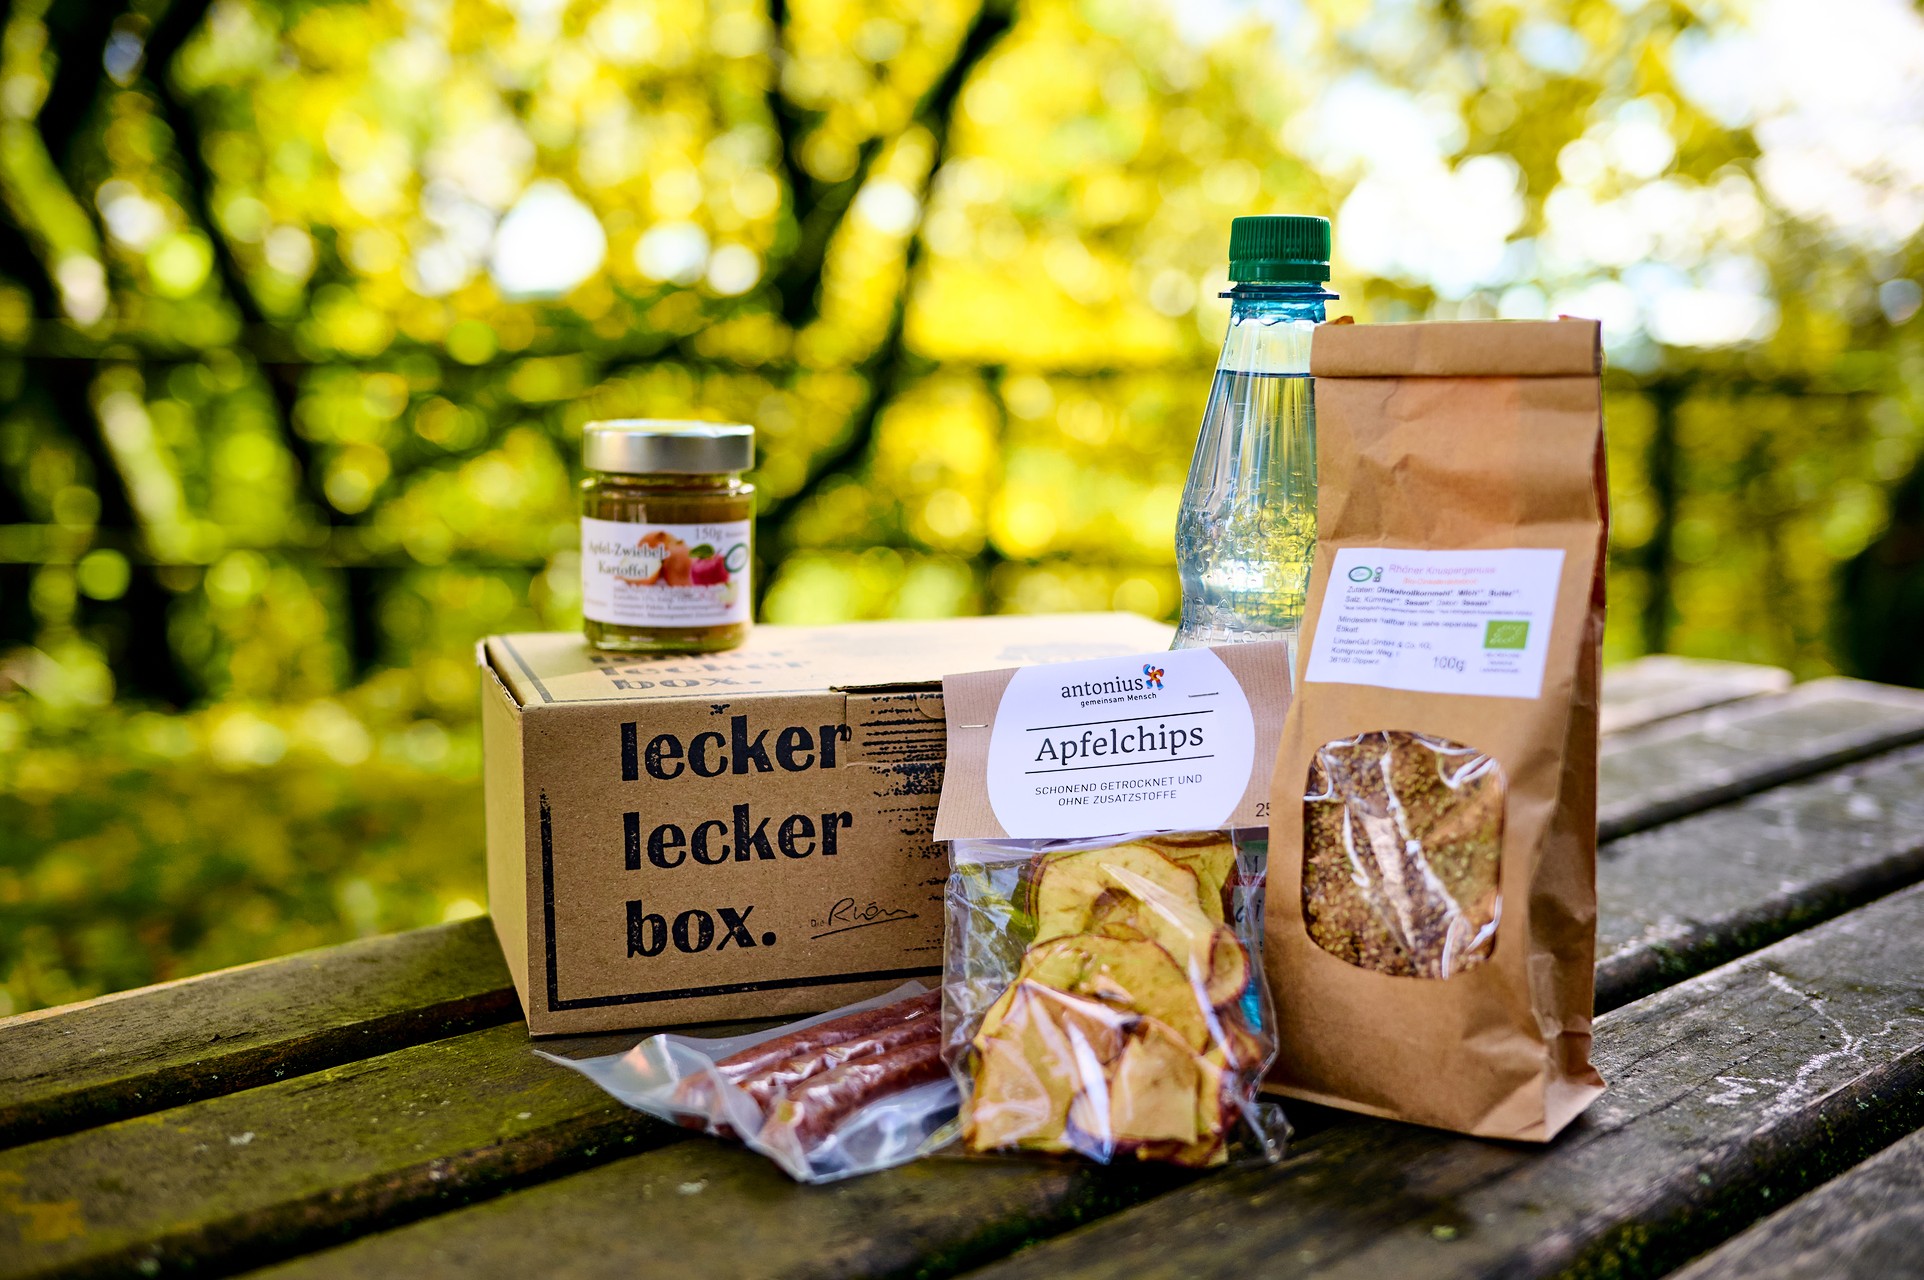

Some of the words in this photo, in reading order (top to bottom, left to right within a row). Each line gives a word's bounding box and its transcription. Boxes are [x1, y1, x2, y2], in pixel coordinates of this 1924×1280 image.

[599, 560, 648, 577] Kartoffel
[1433, 655, 1465, 672] 100g
[611, 676, 763, 690] box.
[1061, 675, 1144, 700] antonius
[1080, 696, 1125, 708] gemeinsam
[1127, 692, 1157, 703] Mensch
[620, 715, 852, 781] lecker
[1034, 722, 1204, 766] Apfelchips
[1035, 782, 1097, 796] SCHONEND
[1100, 776, 1174, 792] GETROCKNET
[1178, 773, 1203, 785] UND
[1058, 795, 1089, 807] OHNE
[1093, 789, 1177, 804] ZUSATZSTOFFE
[622, 803, 853, 871] lecker
[626, 900, 777, 959] box.
